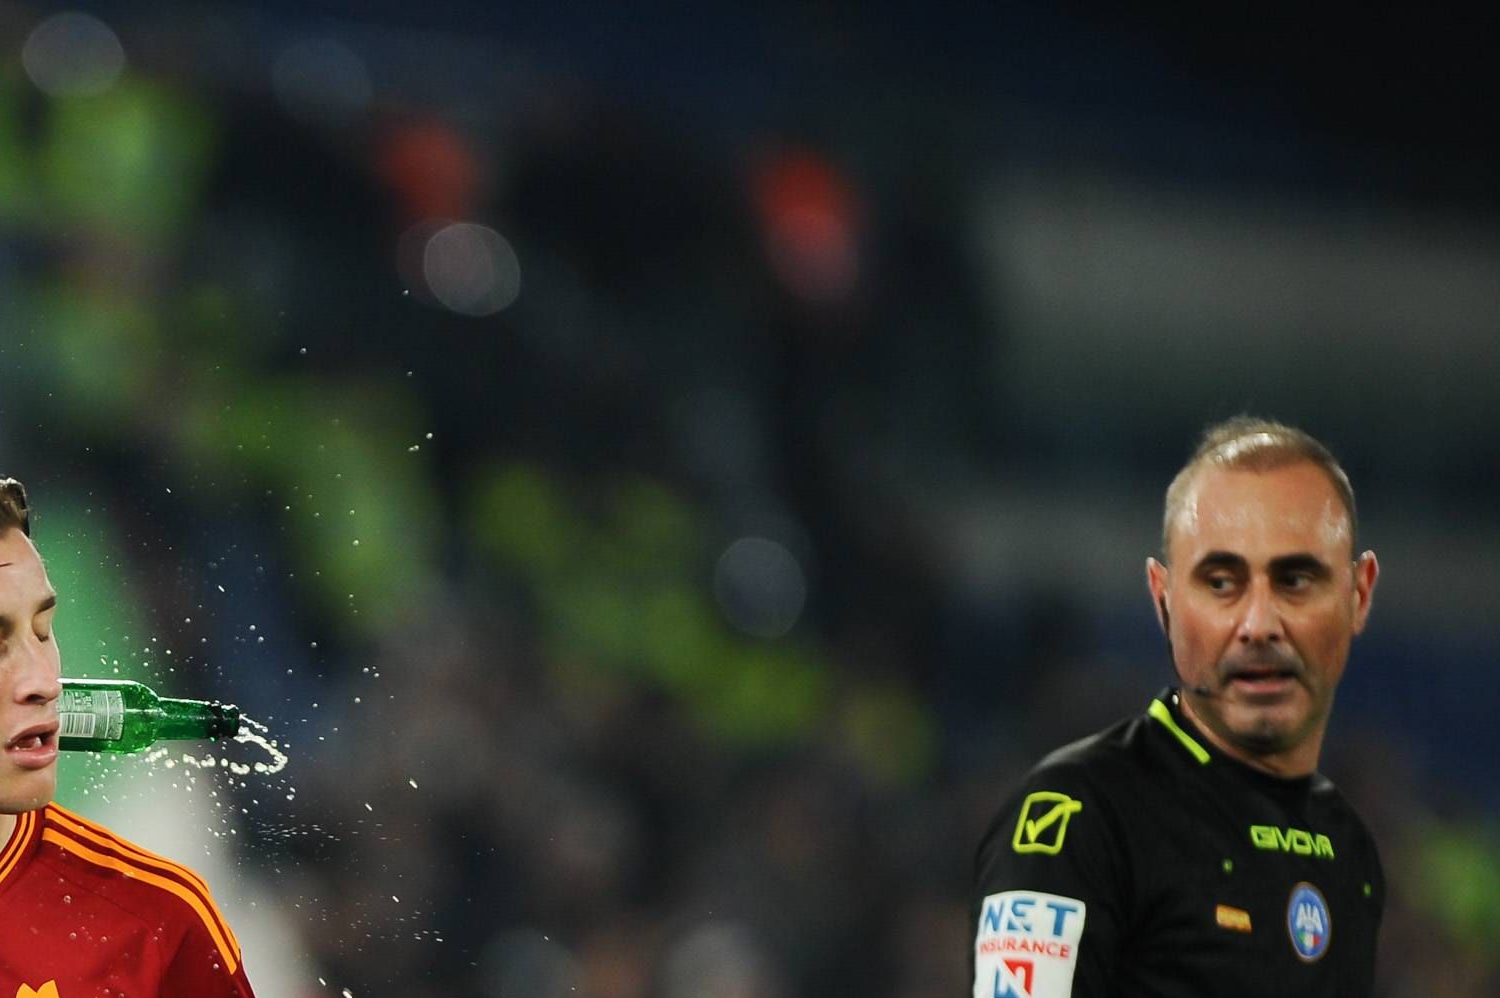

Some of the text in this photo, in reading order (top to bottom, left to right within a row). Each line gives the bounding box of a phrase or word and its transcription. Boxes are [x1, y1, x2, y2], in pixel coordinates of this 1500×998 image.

[1250, 824, 1334, 859] GIVOVA
[984, 899, 1078, 937] NET
[980, 937, 1071, 959] INSURANCE
